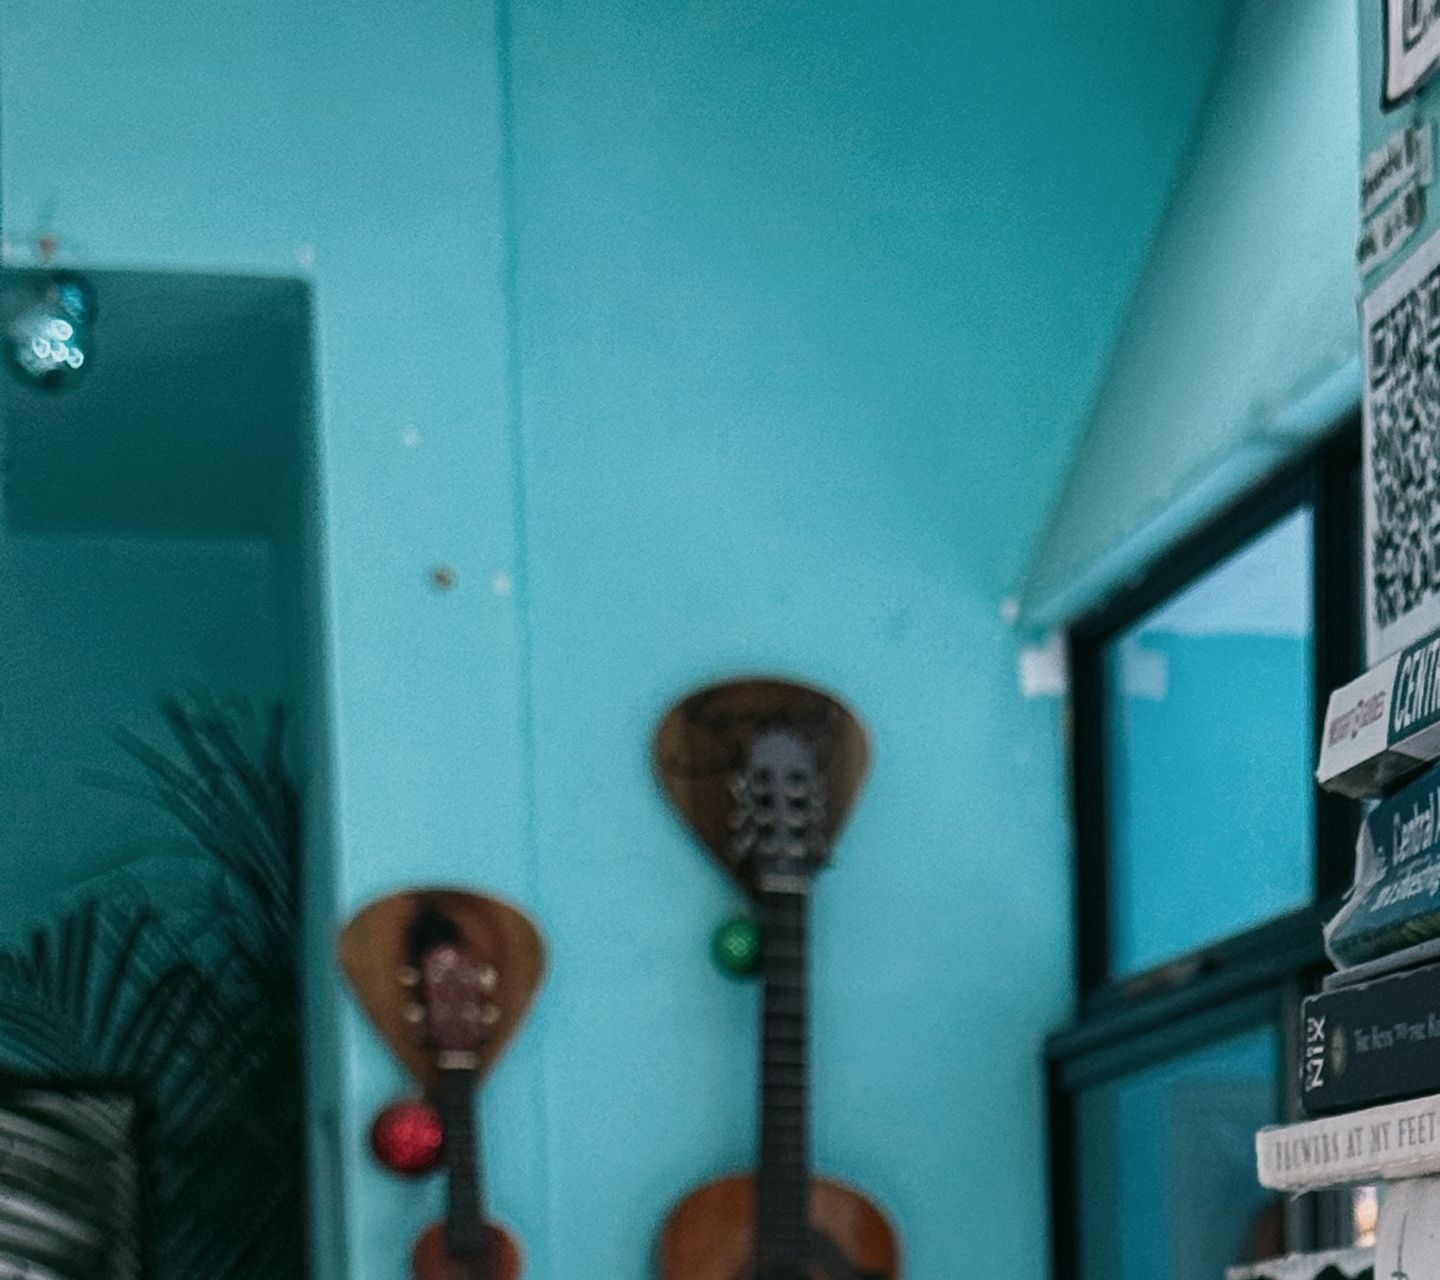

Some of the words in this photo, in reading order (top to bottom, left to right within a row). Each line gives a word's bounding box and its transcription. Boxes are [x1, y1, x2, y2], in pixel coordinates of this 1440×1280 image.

[1346, 1126, 1363, 1158] AT
[1369, 1121, 1391, 1153] MY
[1399, 1111, 1436, 1148] FEET
